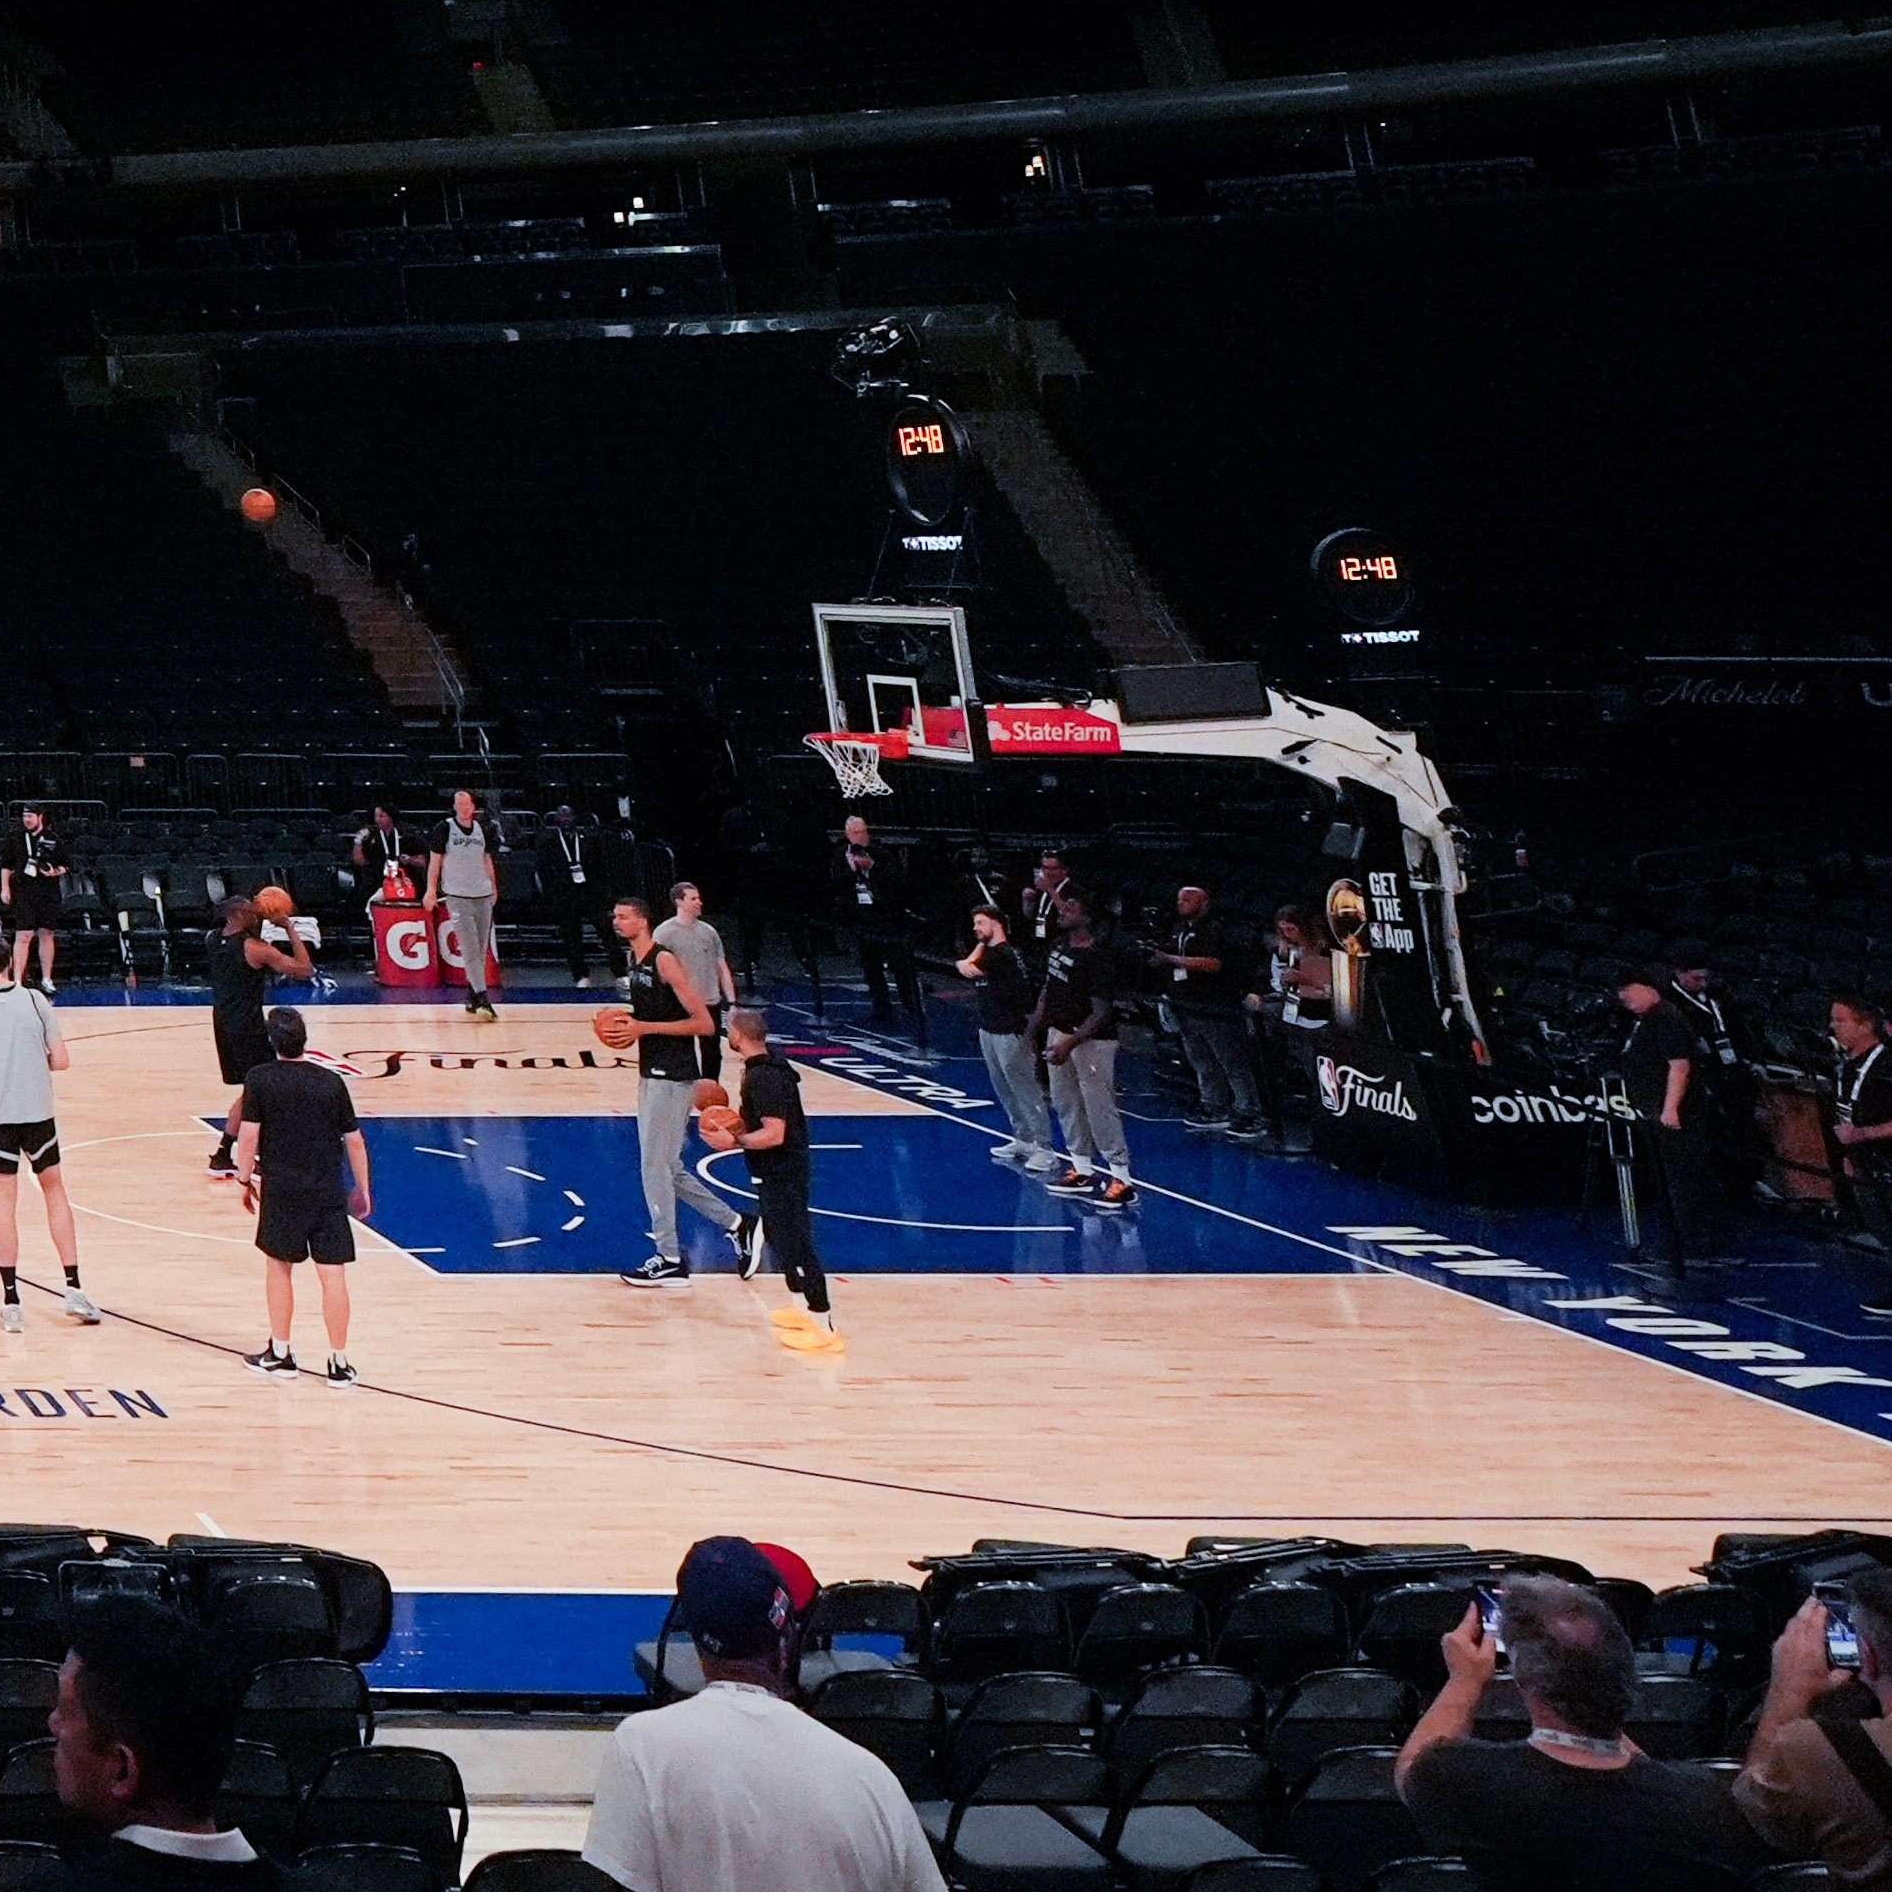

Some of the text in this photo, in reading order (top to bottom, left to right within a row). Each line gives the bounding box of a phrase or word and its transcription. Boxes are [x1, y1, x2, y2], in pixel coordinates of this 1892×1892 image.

[899, 424, 945, 457] 12:48
[920, 535, 963, 551] TISSOT
[1339, 555, 1398, 581] 12:48
[1362, 628, 1420, 645] TISSOT
[1368, 871, 1397, 897] GET
[1371, 897, 1404, 922] THE
[385, 920, 430, 970] G
[1385, 927, 1415, 954] App
[819, 1057, 995, 1109] ULTRA
[1333, 1064, 1418, 1121] Finals
[1470, 1085, 1644, 1124] coinbas
[1326, 1225, 1569, 1280] NEW
[1542, 1295, 1892, 1390] YORK
